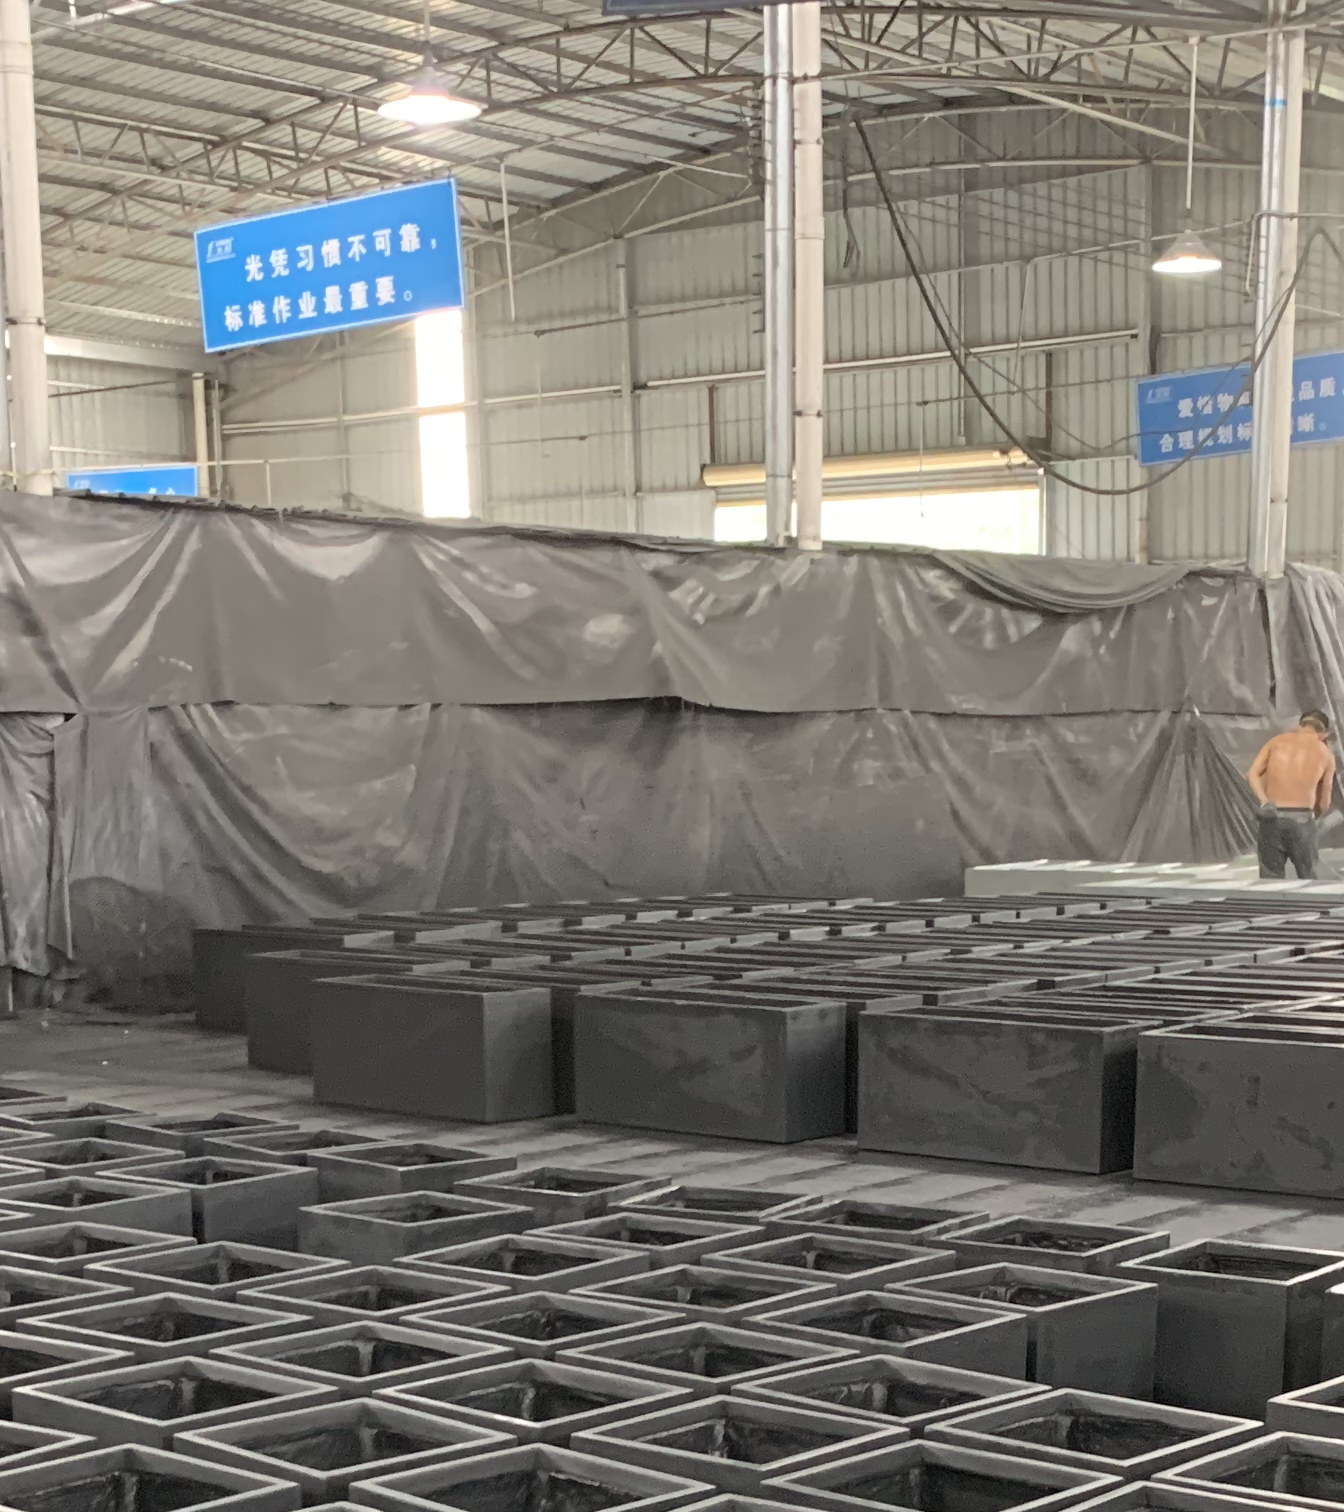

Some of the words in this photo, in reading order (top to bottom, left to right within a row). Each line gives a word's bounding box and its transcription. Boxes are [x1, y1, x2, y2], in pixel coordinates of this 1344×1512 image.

[244, 222, 438, 283] 光凭习惯不可靠，
[223, 275, 413, 332] 标准作业最重要。
